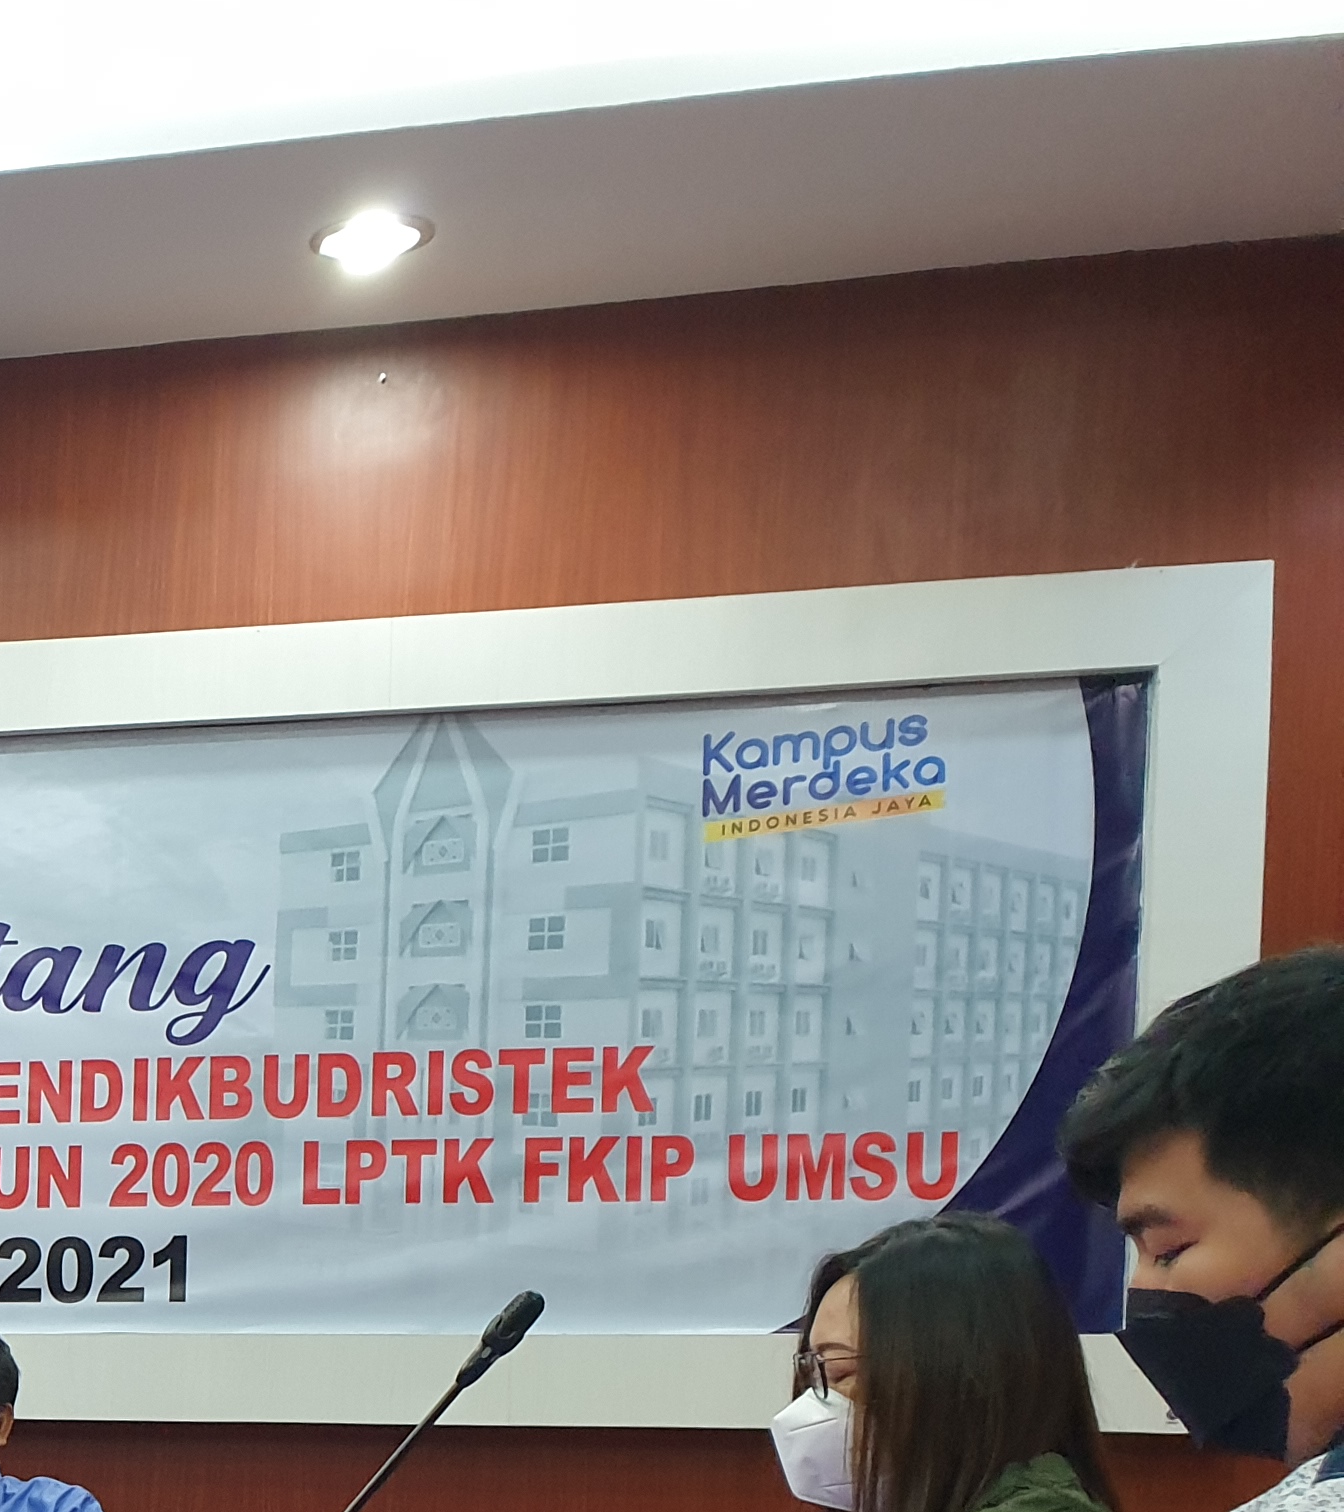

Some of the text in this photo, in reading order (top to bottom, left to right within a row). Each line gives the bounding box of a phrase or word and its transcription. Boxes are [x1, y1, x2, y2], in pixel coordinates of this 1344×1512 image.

[702, 714, 929, 776] Kampus
[702, 752, 947, 818] Merdeka
[720, 794, 933, 837] INDONESIA JAYA
[109, 1140, 275, 1208] 2020
[301, 1137, 495, 1206] LPTK
[522, 1134, 696, 1204] FKIP
[727, 1130, 960, 1203] UMSU
